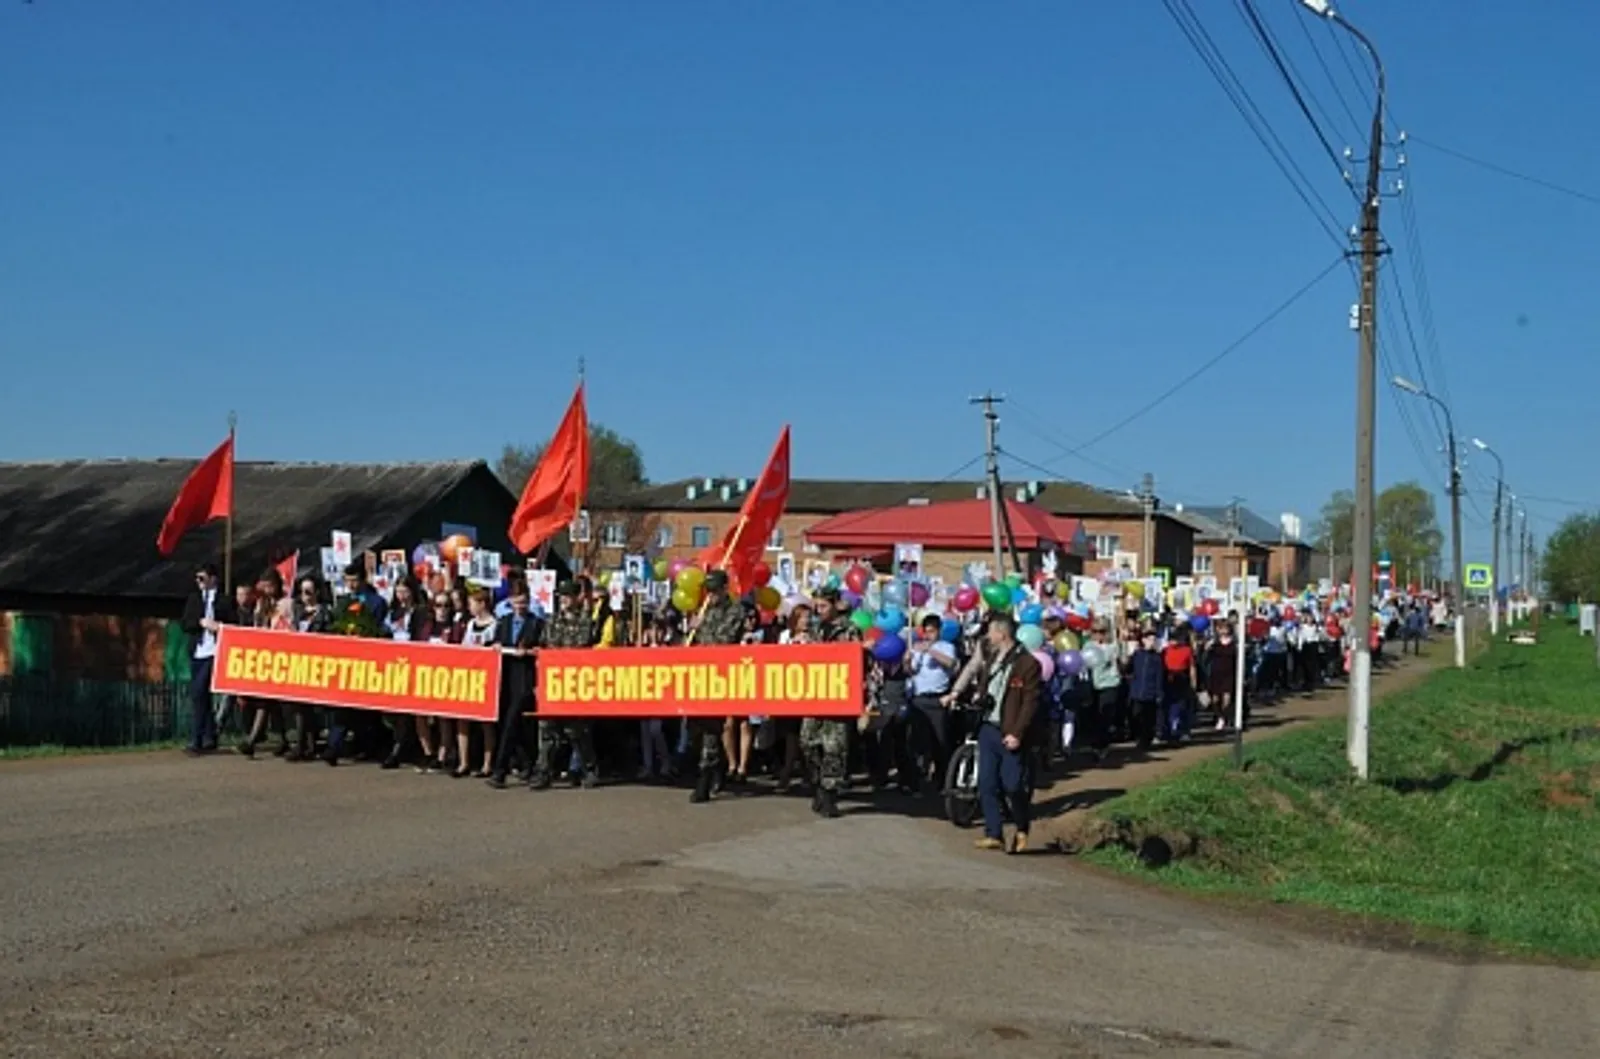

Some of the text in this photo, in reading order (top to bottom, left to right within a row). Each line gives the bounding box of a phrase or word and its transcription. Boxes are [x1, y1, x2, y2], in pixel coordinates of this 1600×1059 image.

[226, 646, 487, 704] БЕССМЕРТНЫЙ ПОЛК
[546, 656, 850, 701] БЕССМЕРТНЫЙ ПОЛК
